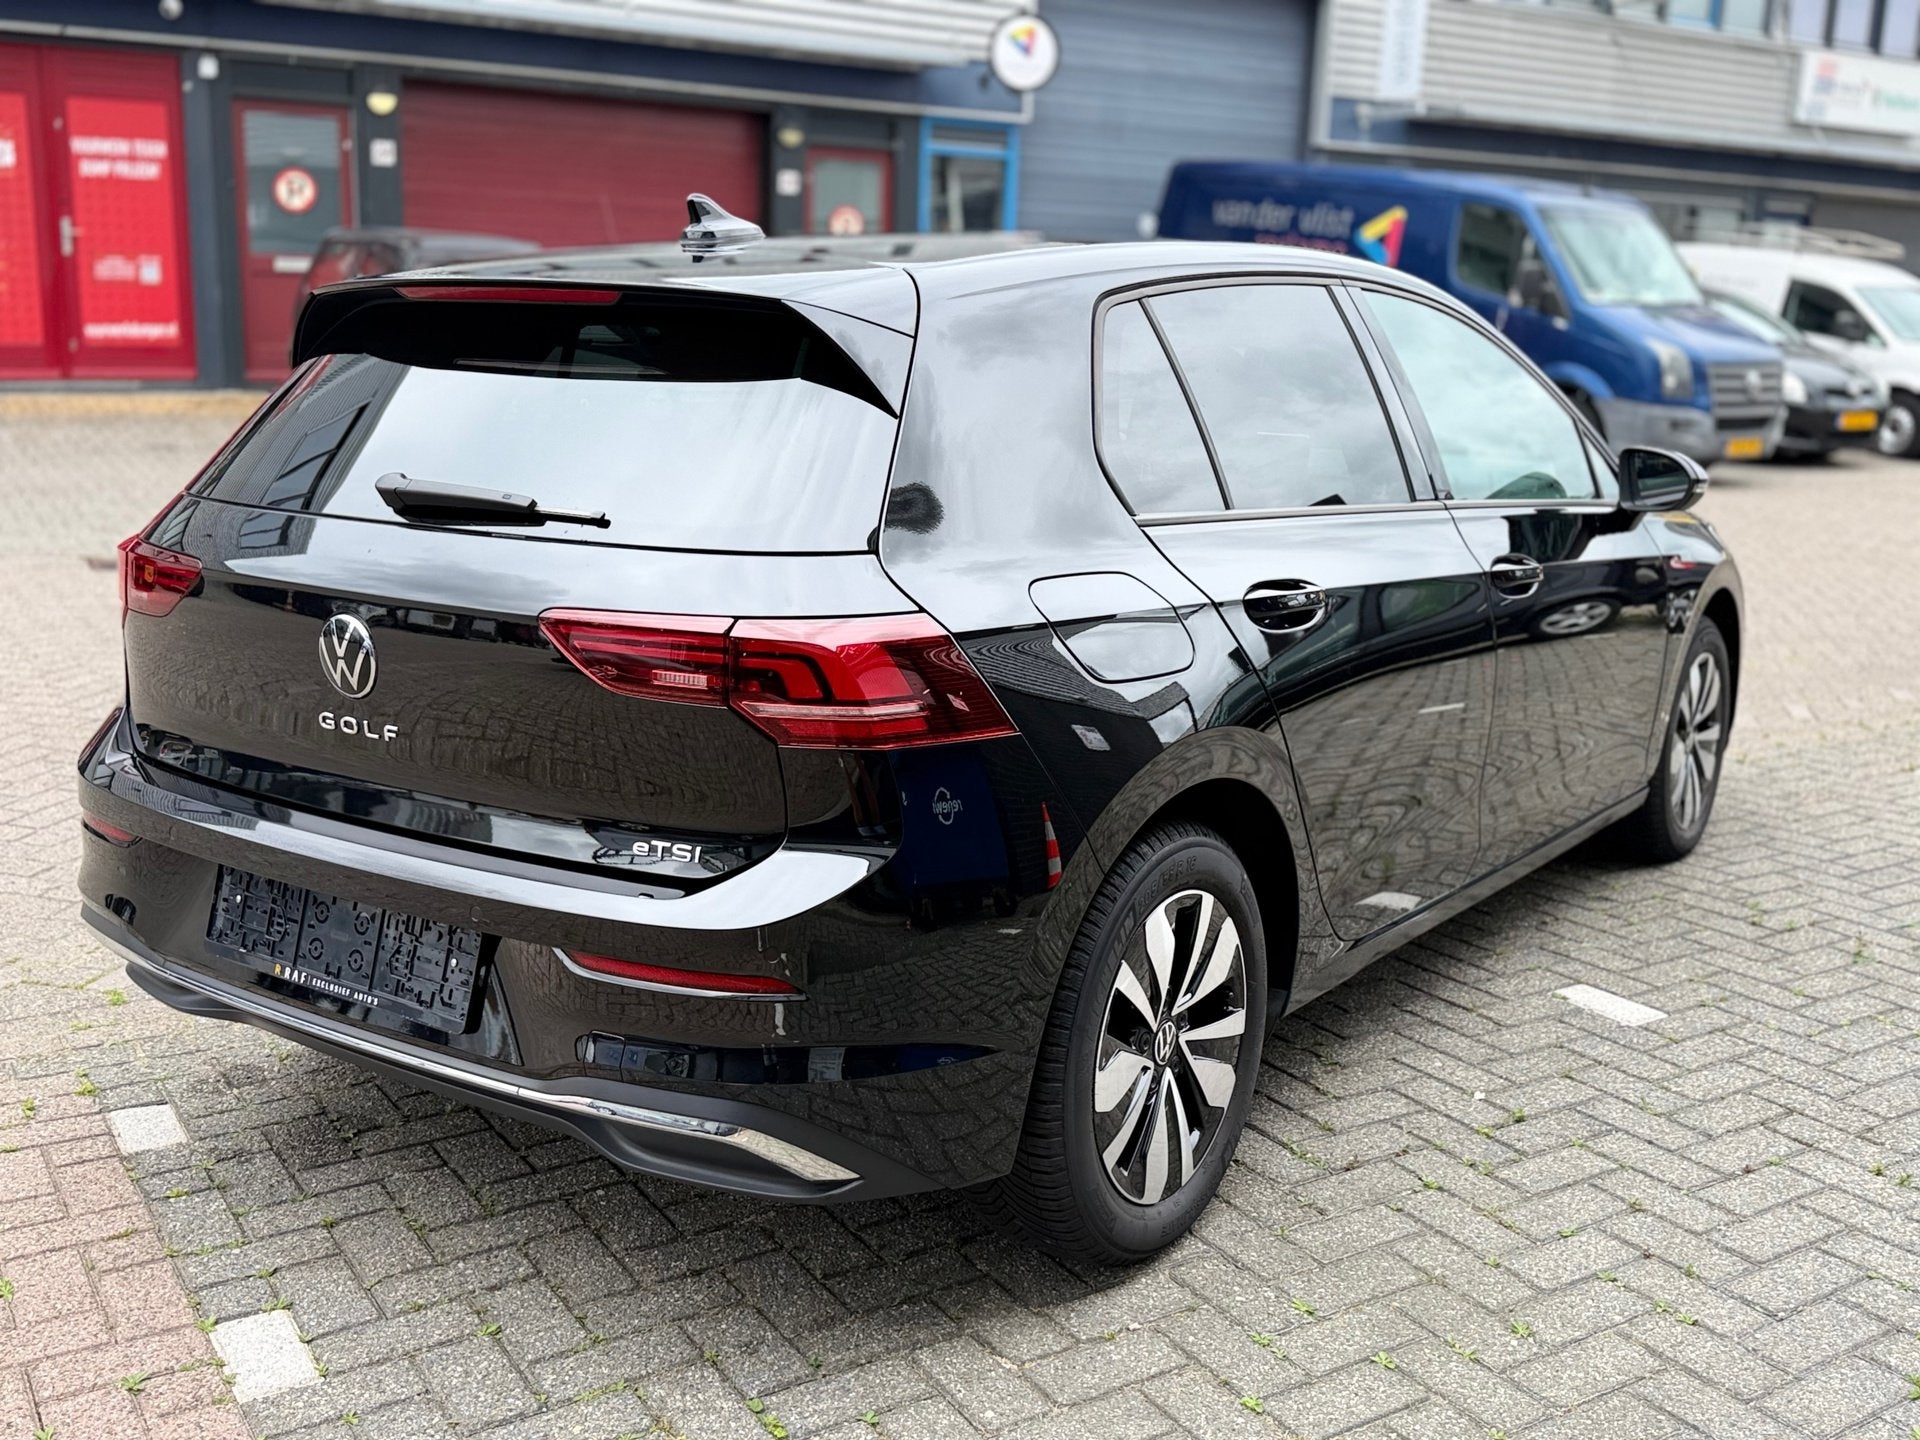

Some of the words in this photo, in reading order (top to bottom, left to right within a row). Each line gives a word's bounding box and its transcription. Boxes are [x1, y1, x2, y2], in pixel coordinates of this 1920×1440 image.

[318, 711, 399, 742] GOLF
[632, 839, 702, 864] eTSI
[284, 966, 307, 984] RAF
[312, 977, 350, 996] EXCLUSIEF
[353, 991, 378, 1006] AUTO'S
